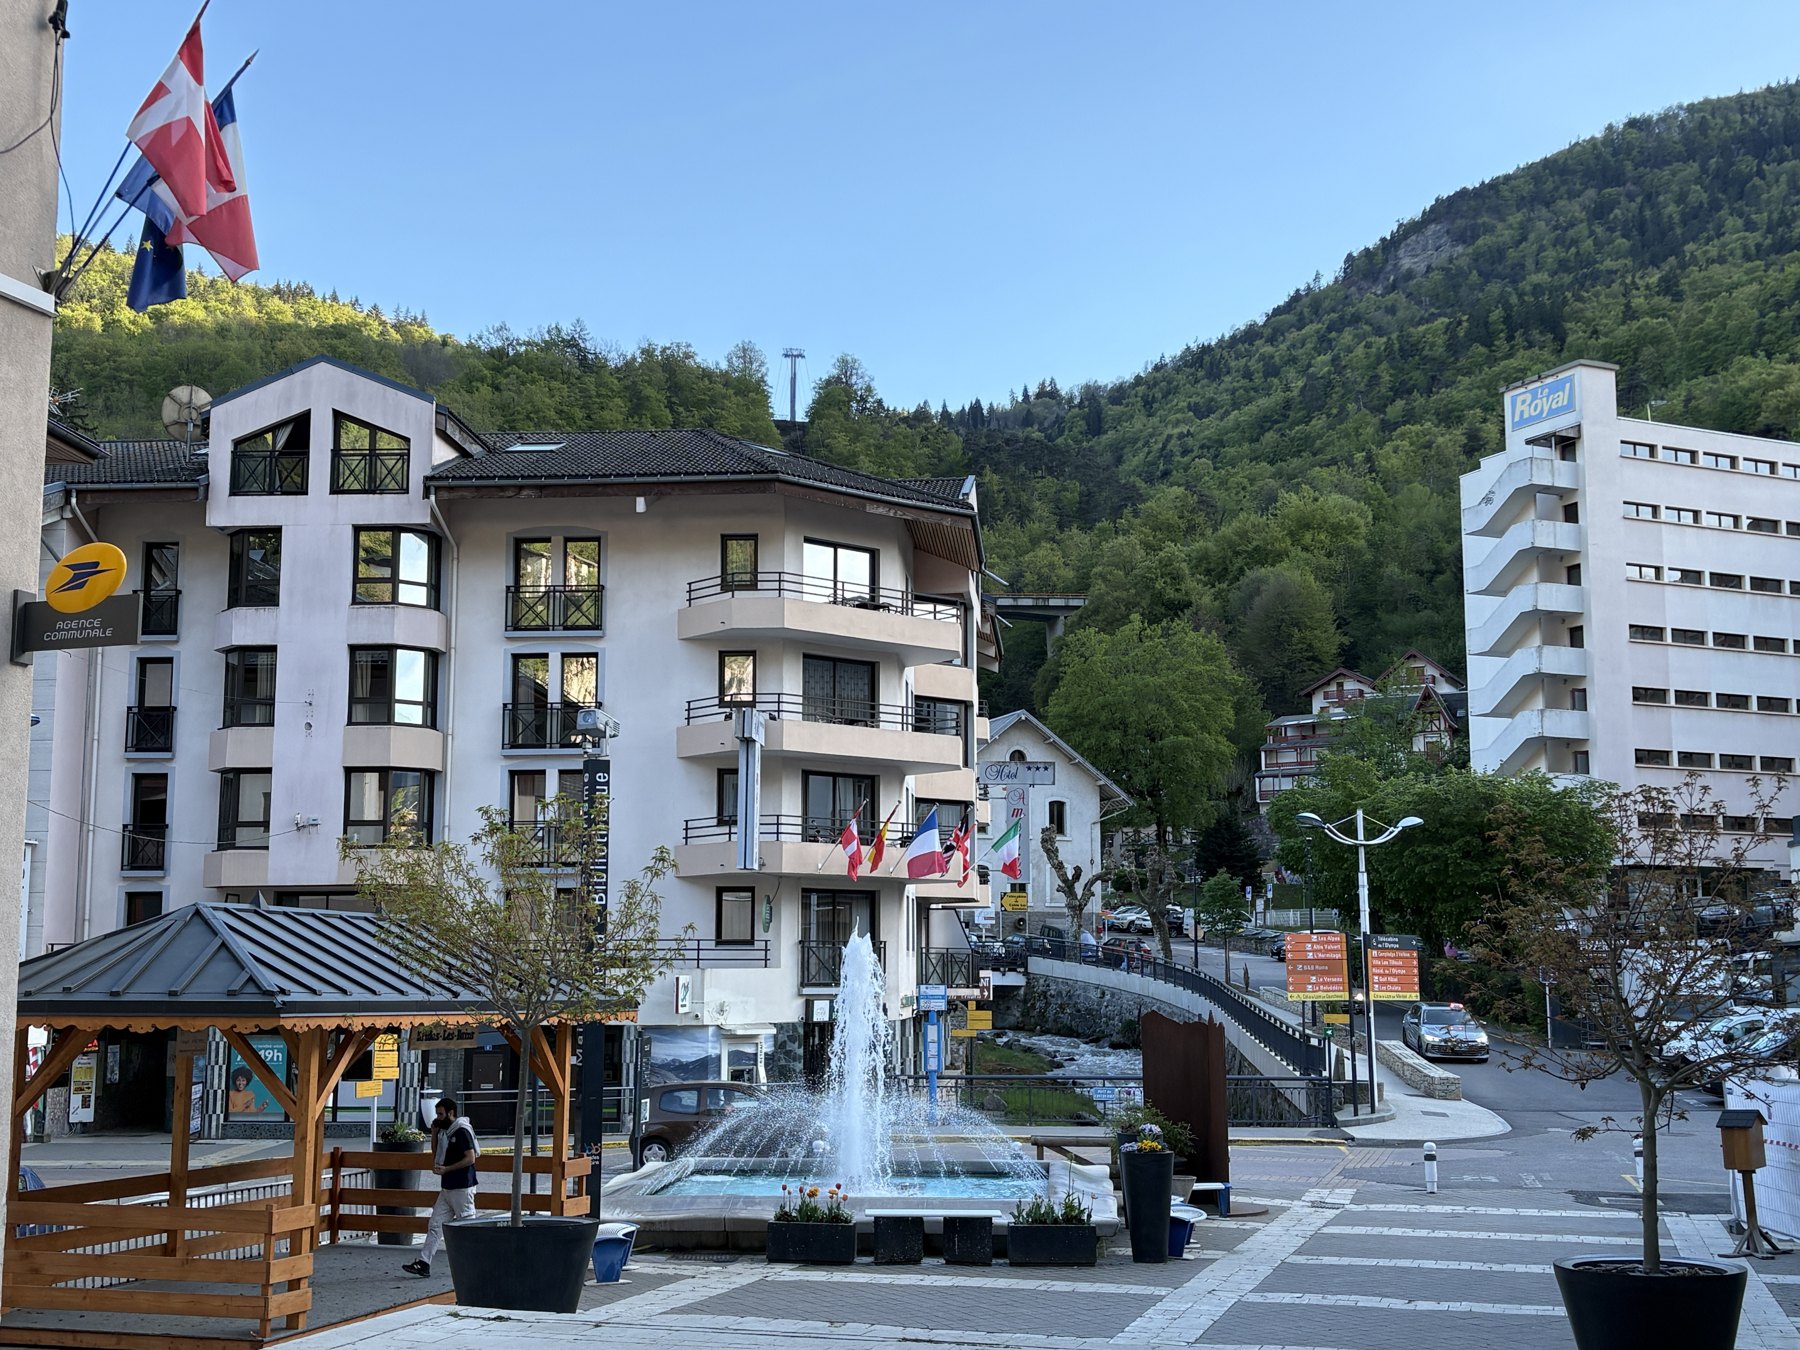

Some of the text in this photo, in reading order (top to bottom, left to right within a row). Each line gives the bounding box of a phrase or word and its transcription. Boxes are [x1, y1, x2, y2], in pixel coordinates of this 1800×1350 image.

[1538, 388, 1549, 398] Le
[1514, 383, 1570, 422] Royal
[55, 618, 102, 630] AGENCE
[44, 629, 113, 640] COMMUNALE
